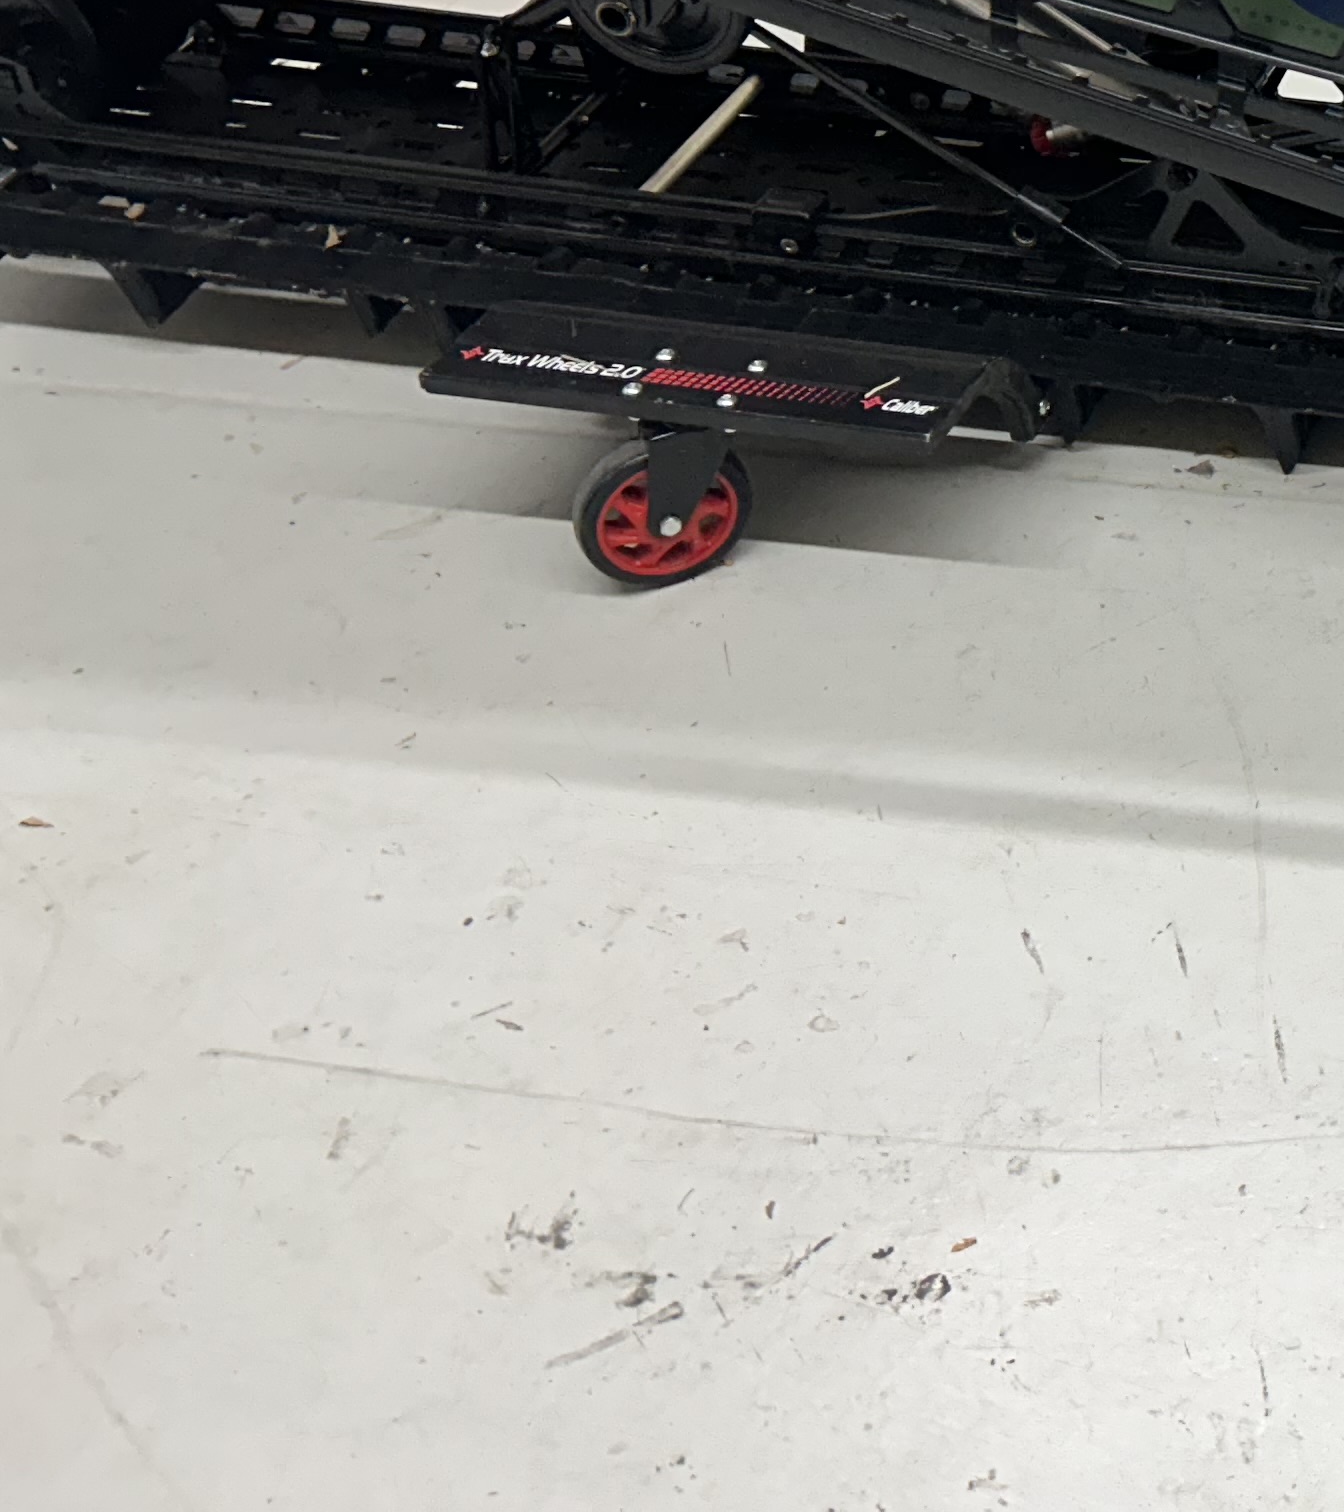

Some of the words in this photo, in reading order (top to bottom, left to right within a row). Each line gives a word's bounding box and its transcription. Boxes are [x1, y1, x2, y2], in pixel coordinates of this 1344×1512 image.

[480, 348, 530, 367] Trux
[526, 354, 603, 375] Wheels
[600, 364, 644, 379] 2.0
[880, 398, 939, 416] Caliber
